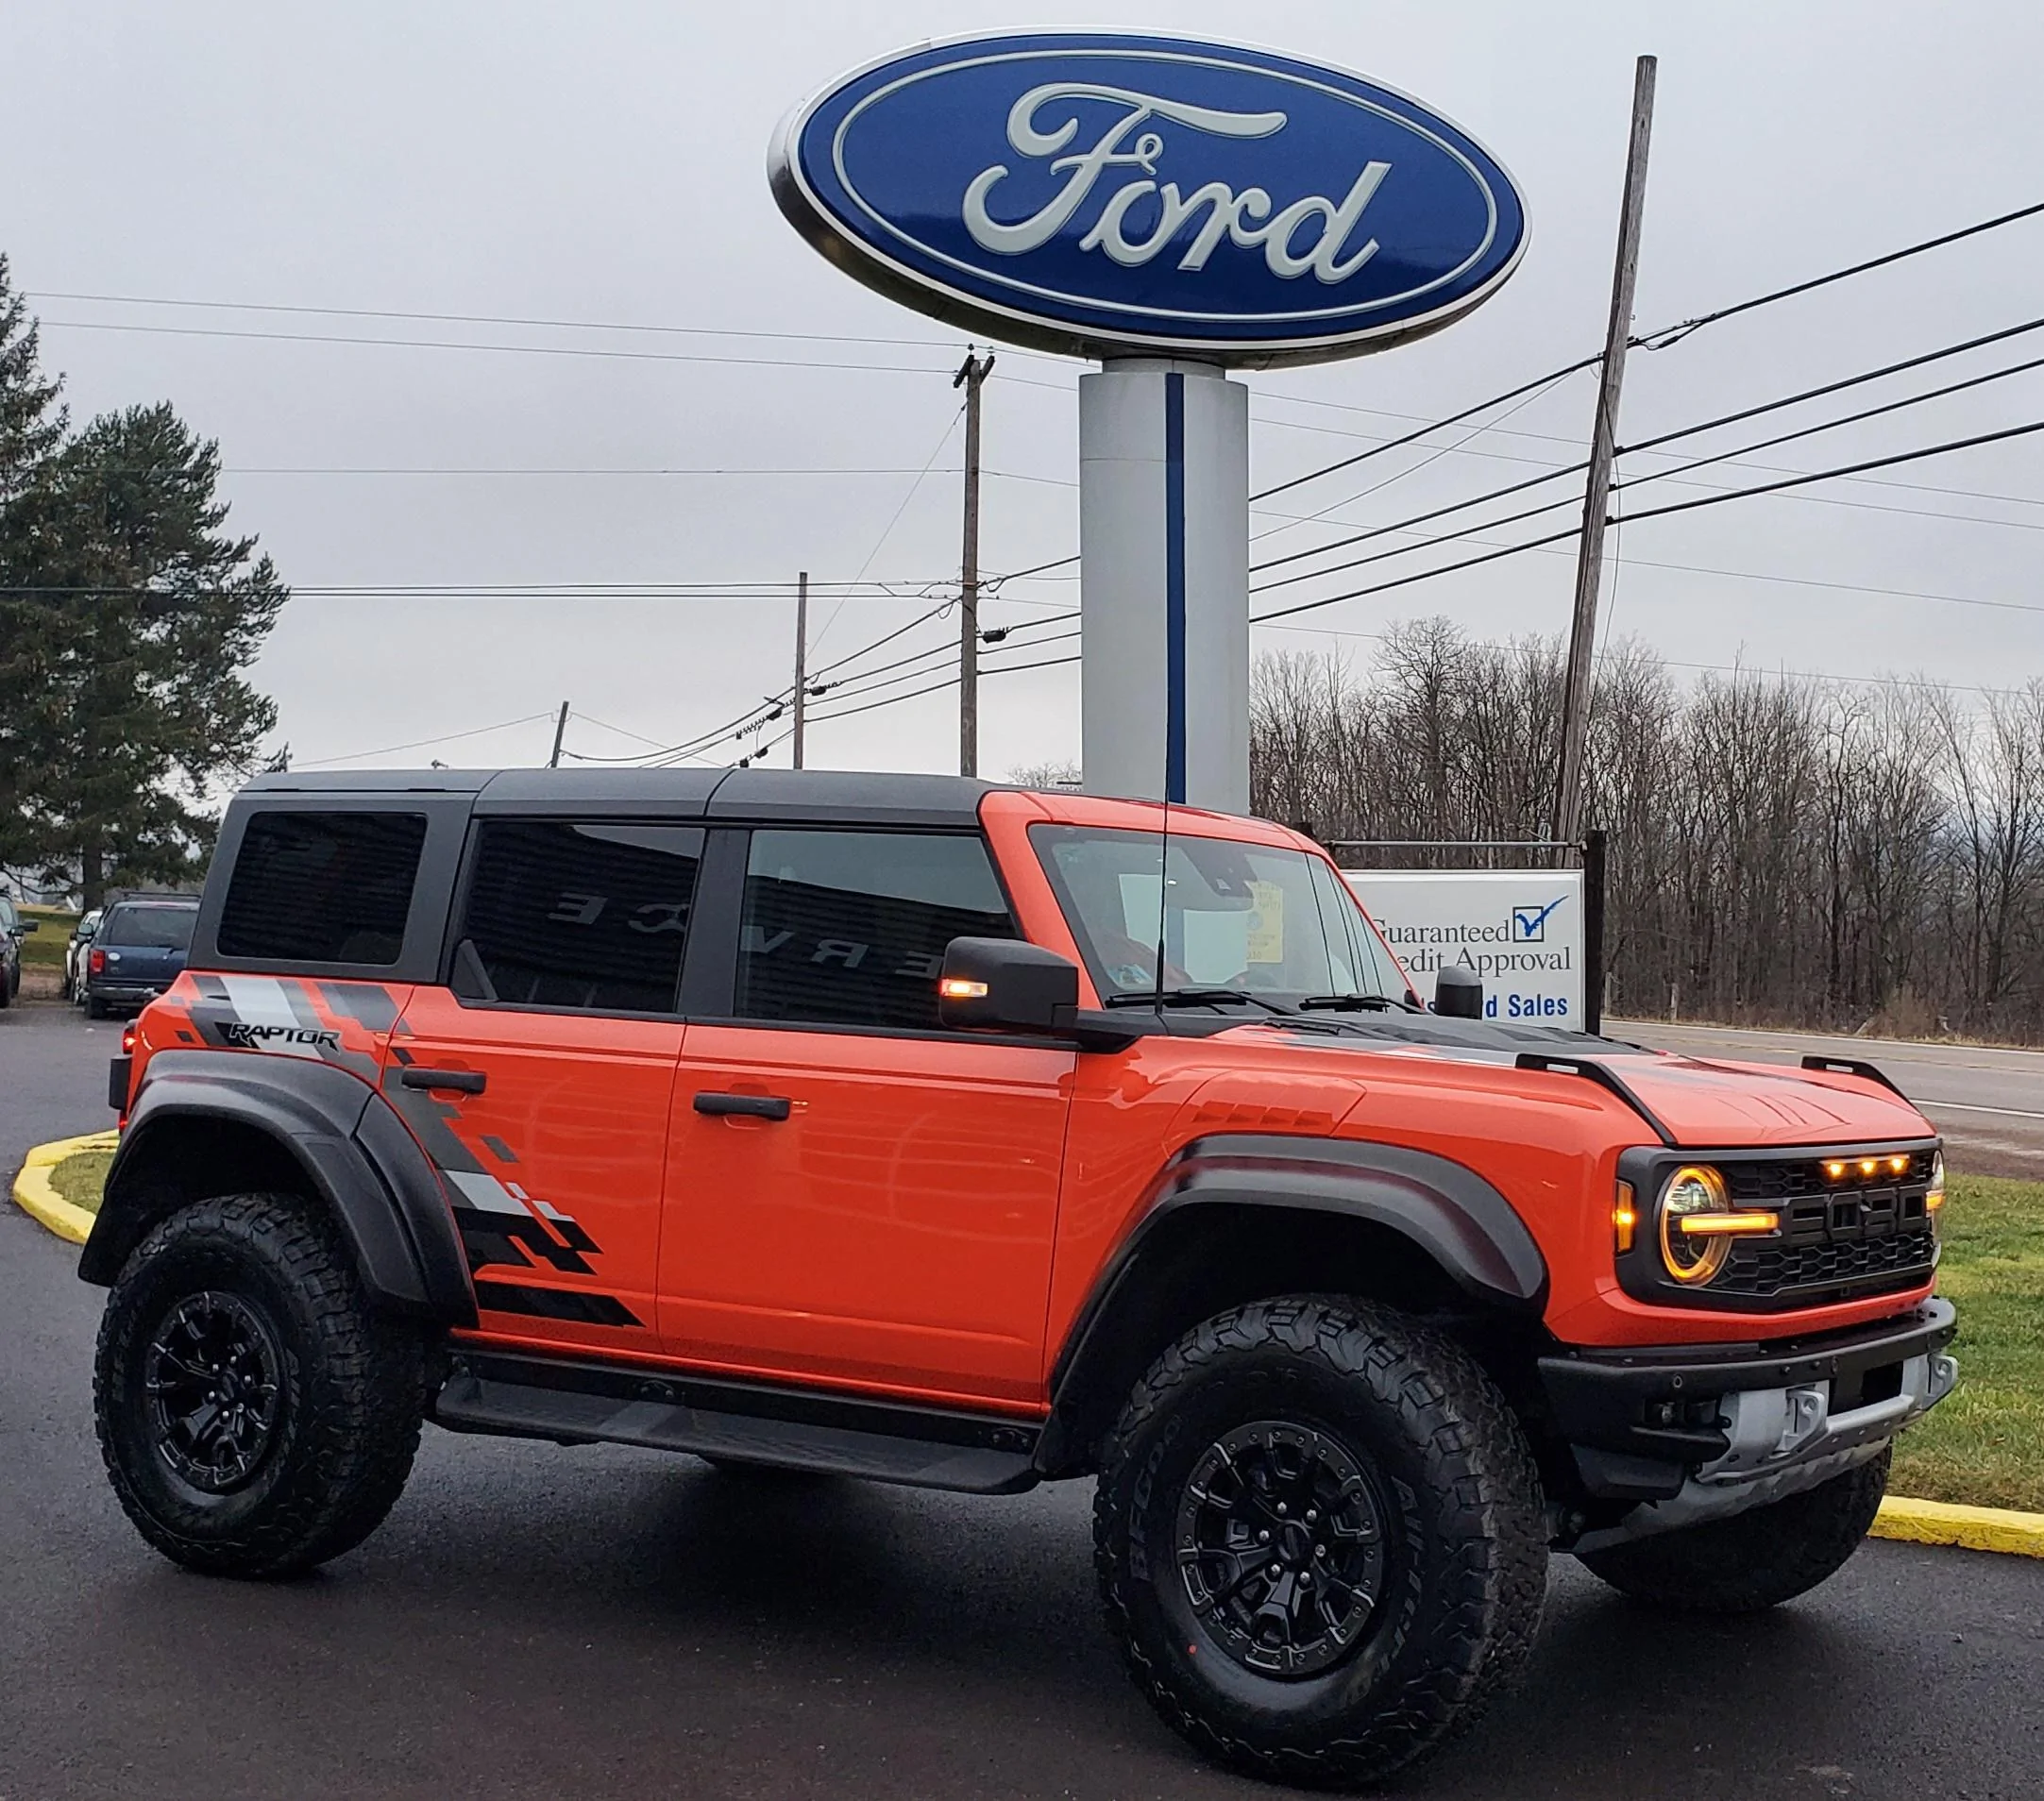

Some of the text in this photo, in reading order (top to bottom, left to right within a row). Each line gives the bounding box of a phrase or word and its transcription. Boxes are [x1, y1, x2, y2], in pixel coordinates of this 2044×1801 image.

[962, 82, 1392, 284] Ford
[1456, 947, 1572, 977] Approval
[1509, 993, 1568, 1018] Sales
[229, 1022, 342, 1054] RAPTOR
